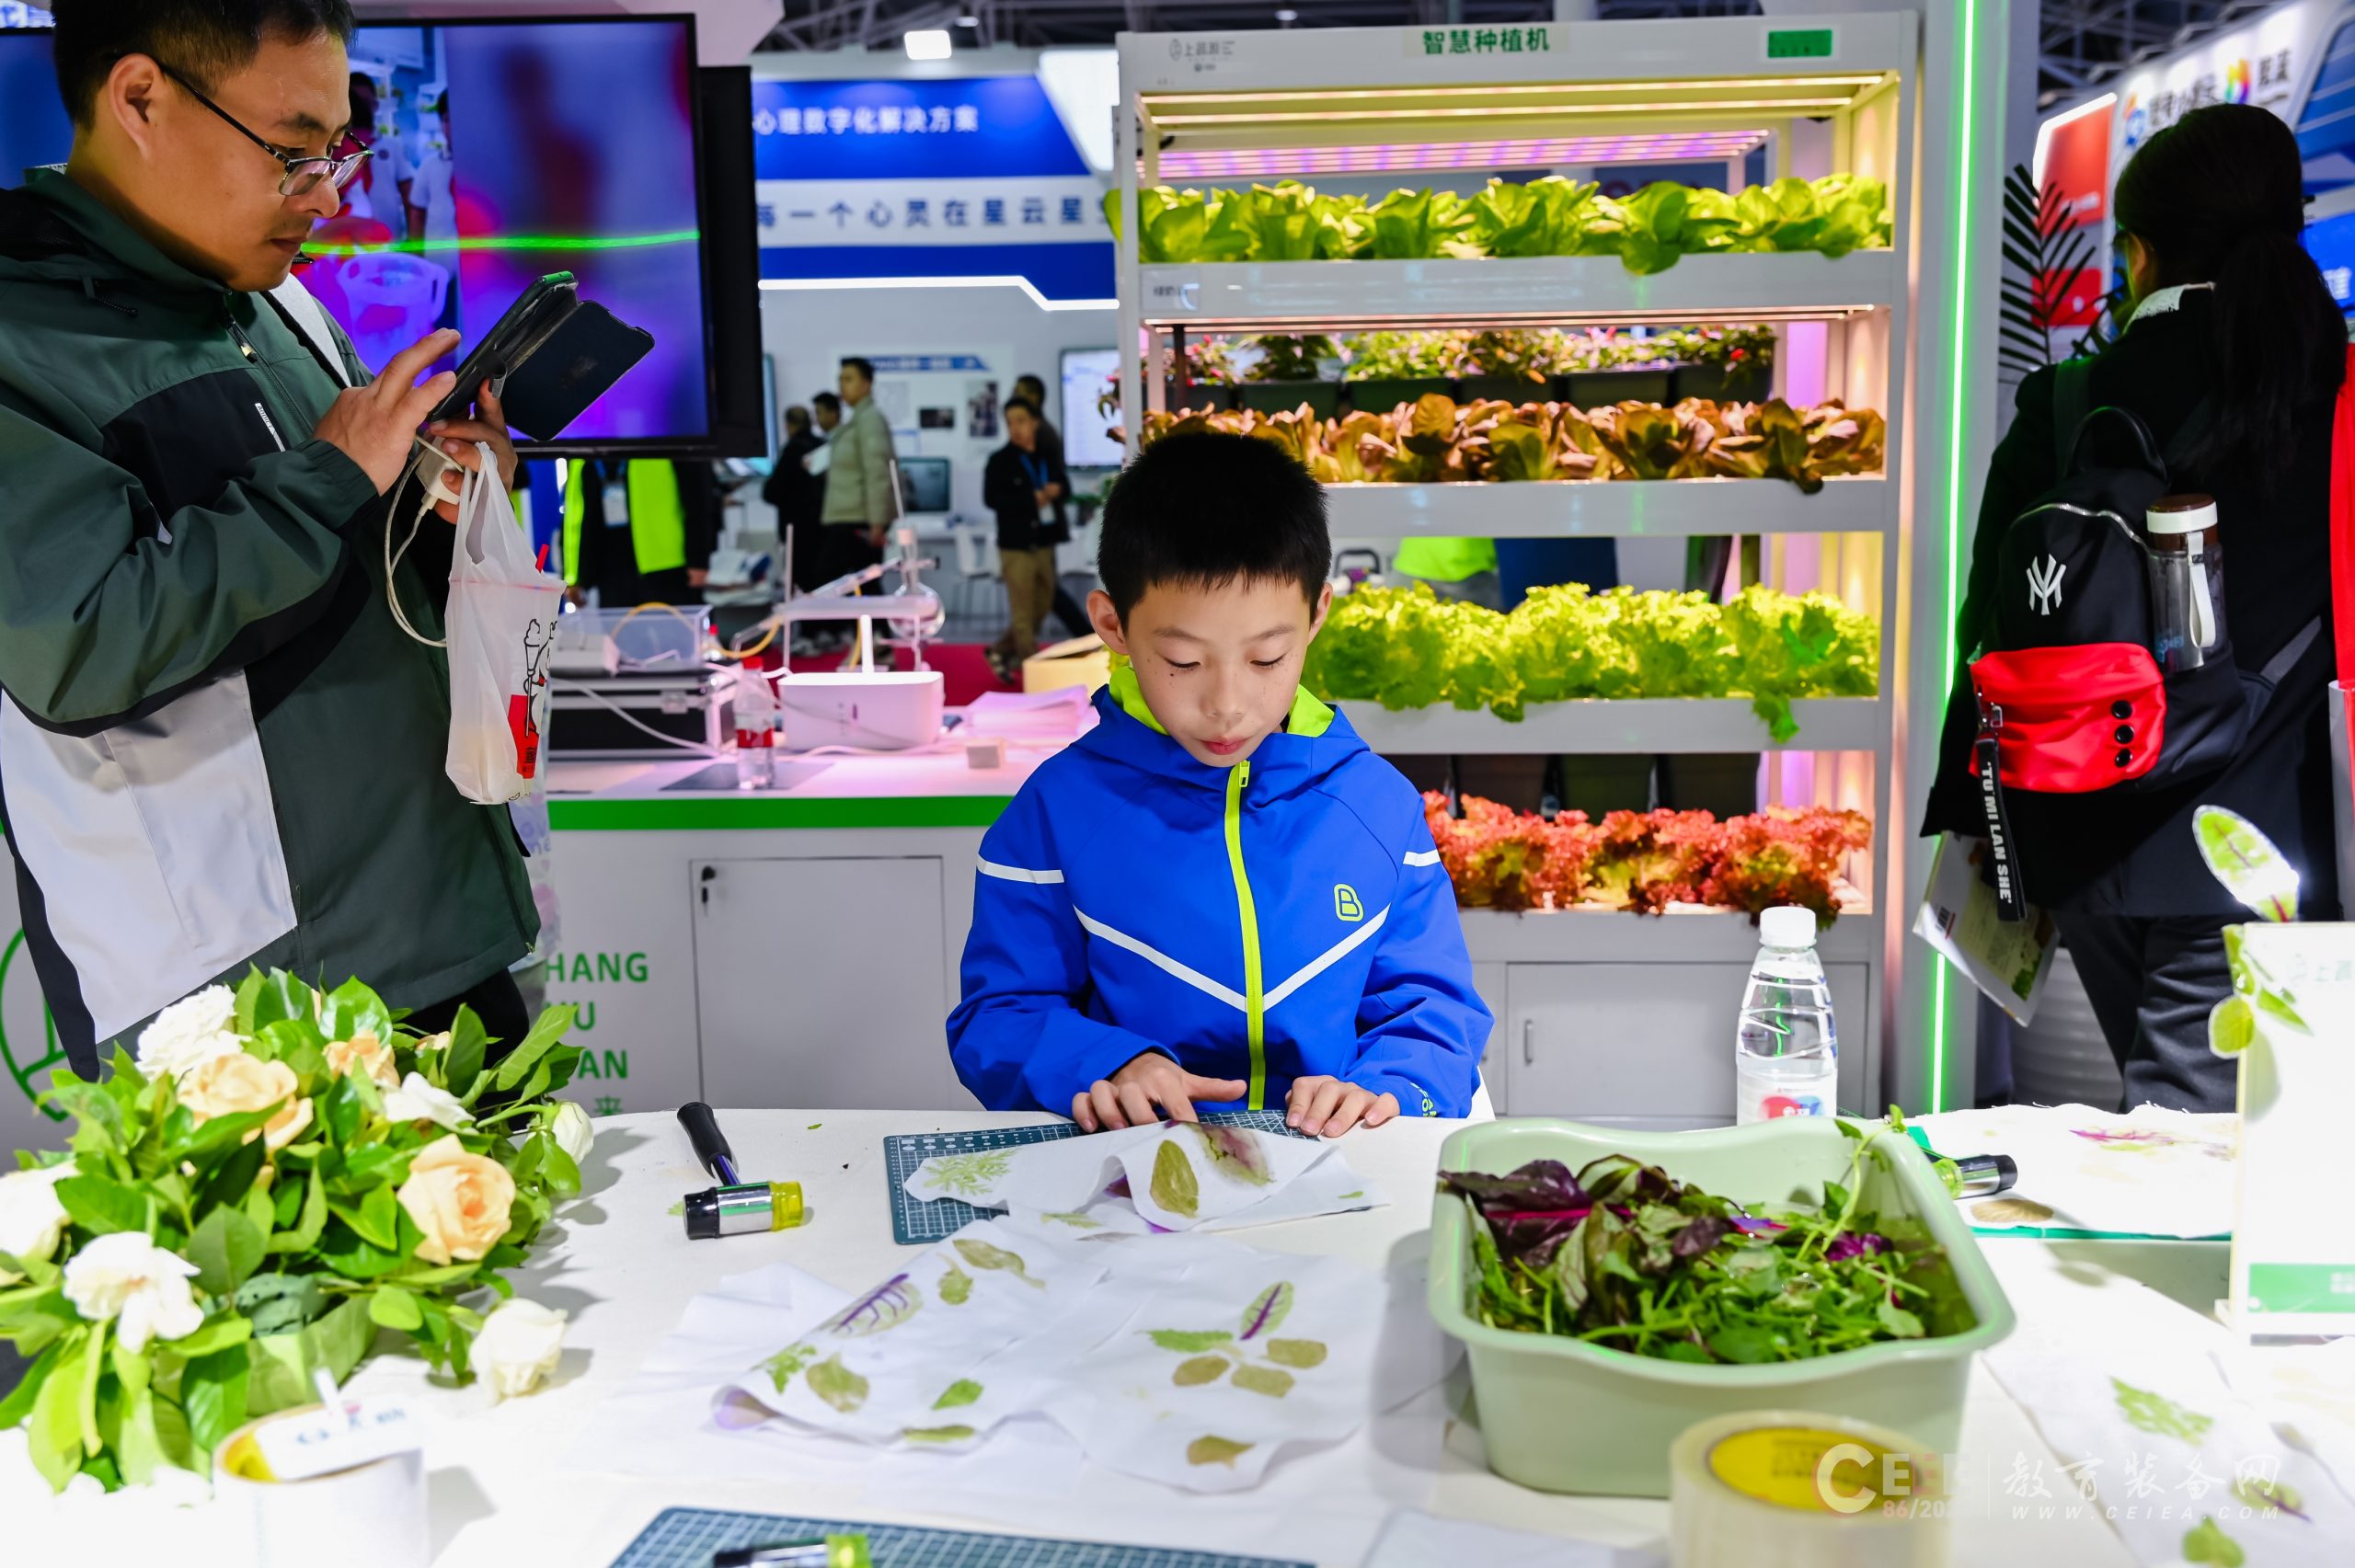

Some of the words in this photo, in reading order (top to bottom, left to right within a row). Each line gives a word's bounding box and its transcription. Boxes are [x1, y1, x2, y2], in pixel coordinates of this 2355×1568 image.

[1423, 28, 1550, 54] 智慧种植机
[752, 105, 979, 135] 心理数字化解决方案
[757, 196, 1107, 230] 每一个心灵在星云星
[2026, 553, 2066, 615] NY
[1990, 824, 2006, 860] LAN
